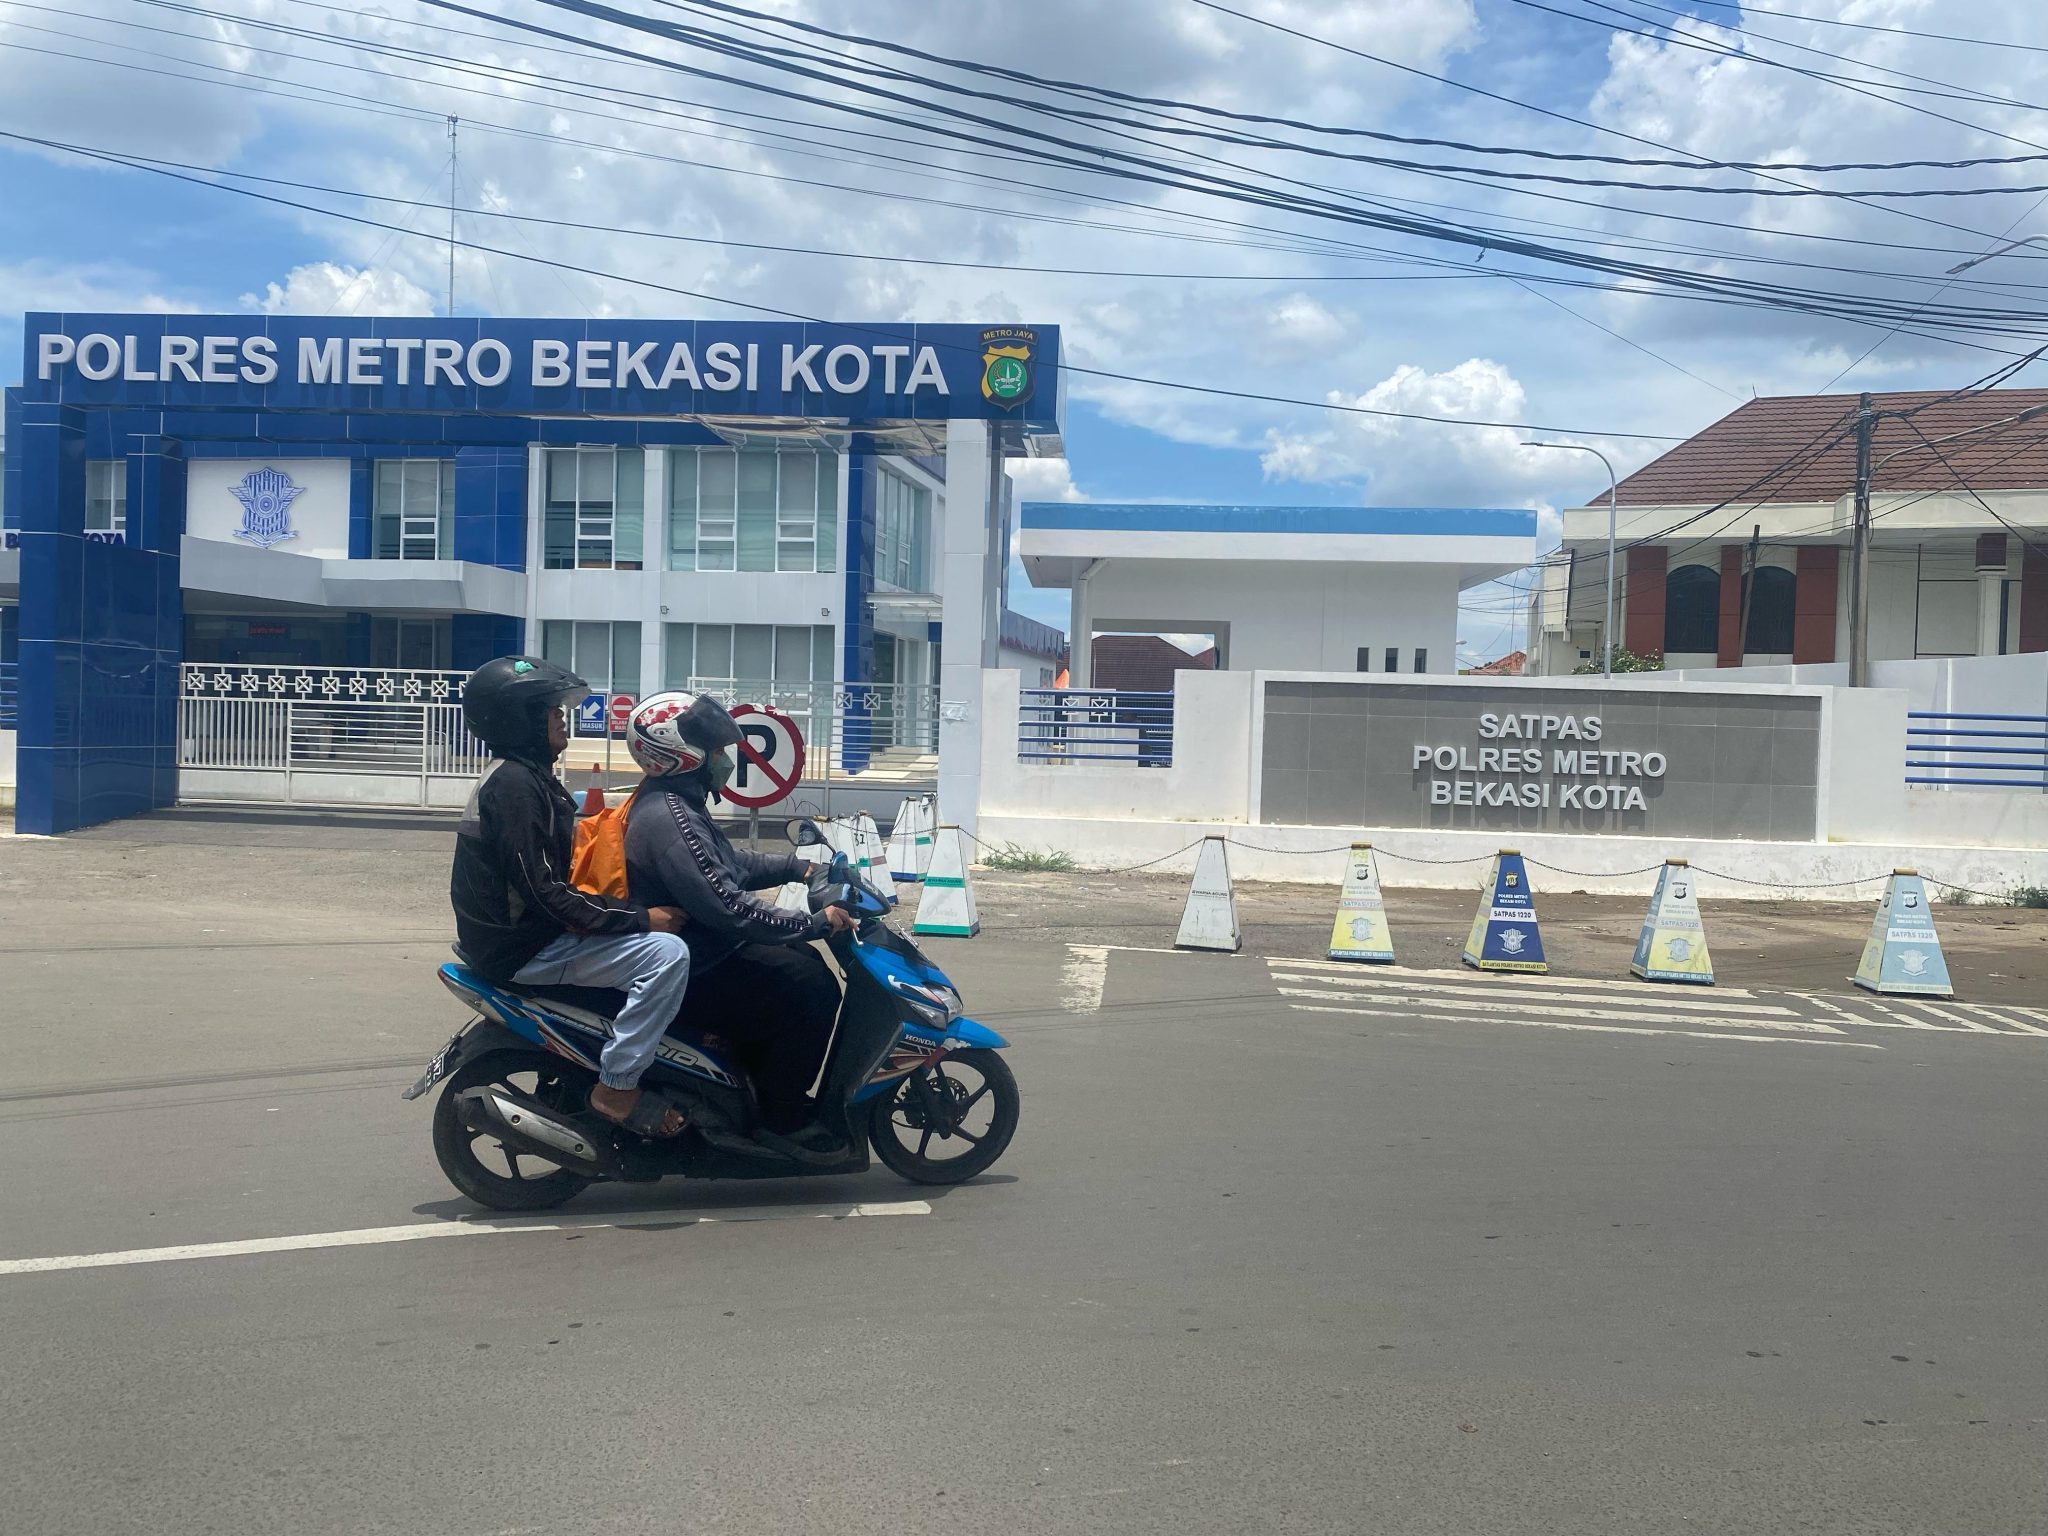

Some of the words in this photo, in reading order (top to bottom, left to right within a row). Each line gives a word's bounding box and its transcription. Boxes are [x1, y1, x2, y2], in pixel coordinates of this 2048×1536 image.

[983, 329, 1012, 341] METRO
[1013, 330, 1034, 341] JAYA
[38, 333, 279, 385] POLRES
[298, 337, 513, 388] METRO
[531, 339, 760, 392] BEKASI
[780, 343, 951, 396] KOTA
[581, 722, 603, 730] MASUK
[1478, 713, 1602, 741] SATPAS
[1412, 745, 1543, 774] POLRES
[1553, 749, 1667, 778] METRO
[1430, 780, 1549, 809] BEKASI
[1560, 784, 1647, 811] KOTA
[1494, 910, 1516, 918] SATPAS
[904, 1034, 937, 1047] HONDA
